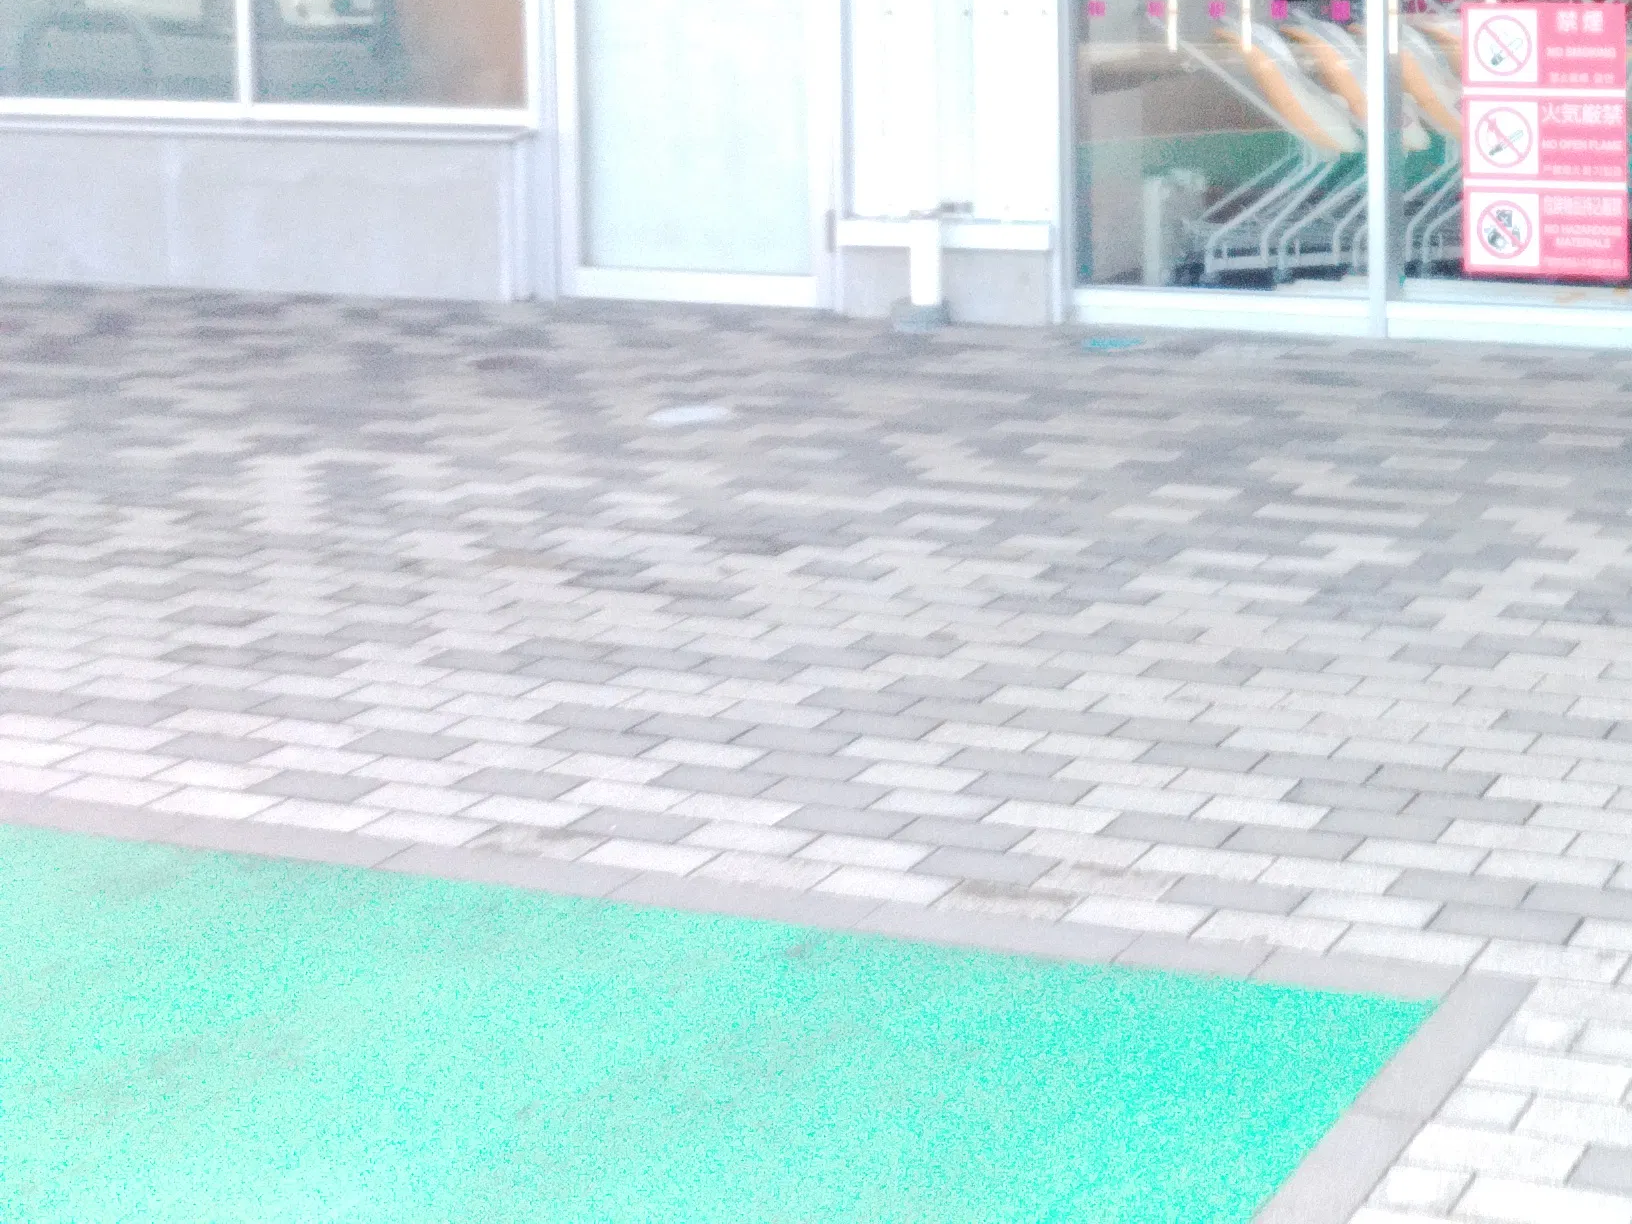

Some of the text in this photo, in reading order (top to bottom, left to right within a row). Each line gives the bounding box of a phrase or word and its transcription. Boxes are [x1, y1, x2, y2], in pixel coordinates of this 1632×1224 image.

[1556, 10, 1604, 33] 禁煙
[1546, 46, 1617, 59] NO SMOKING
[1541, 102, 1623, 125] 火気厳禁
[1542, 139, 1623, 152] NO OPEN FLAME
